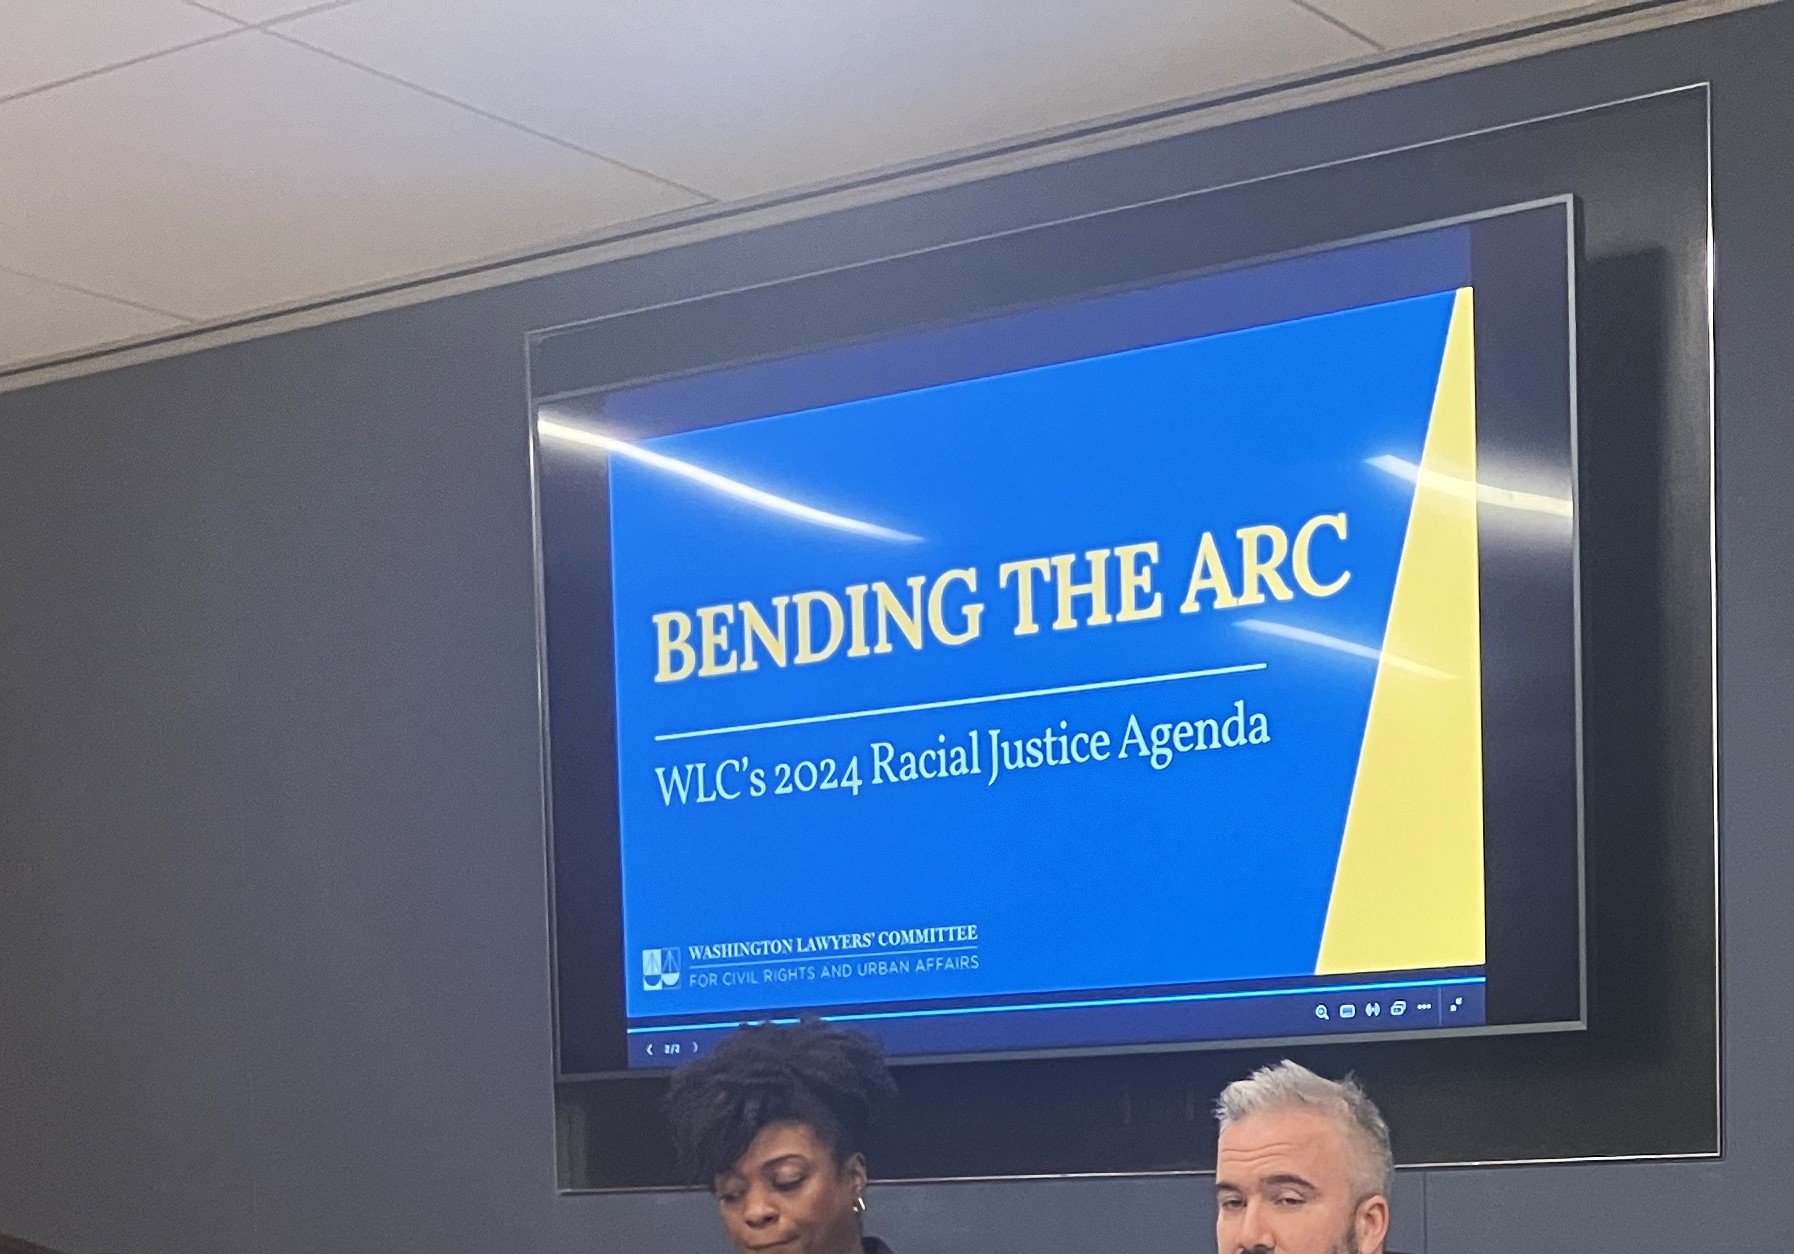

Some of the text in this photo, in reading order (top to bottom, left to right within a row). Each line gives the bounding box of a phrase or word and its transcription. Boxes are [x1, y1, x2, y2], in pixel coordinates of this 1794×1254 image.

[652, 512, 1352, 684] BENDING THE ARC
[654, 700, 1271, 807] WLC's 2024 Racial Justice Agenda
[689, 939, 794, 961] WASHINGTON
[878, 924, 978, 948] COMMITTEE
[689, 955, 981, 988] FOR CIVIL RIGHTS AND URBAN AFFAIRS
